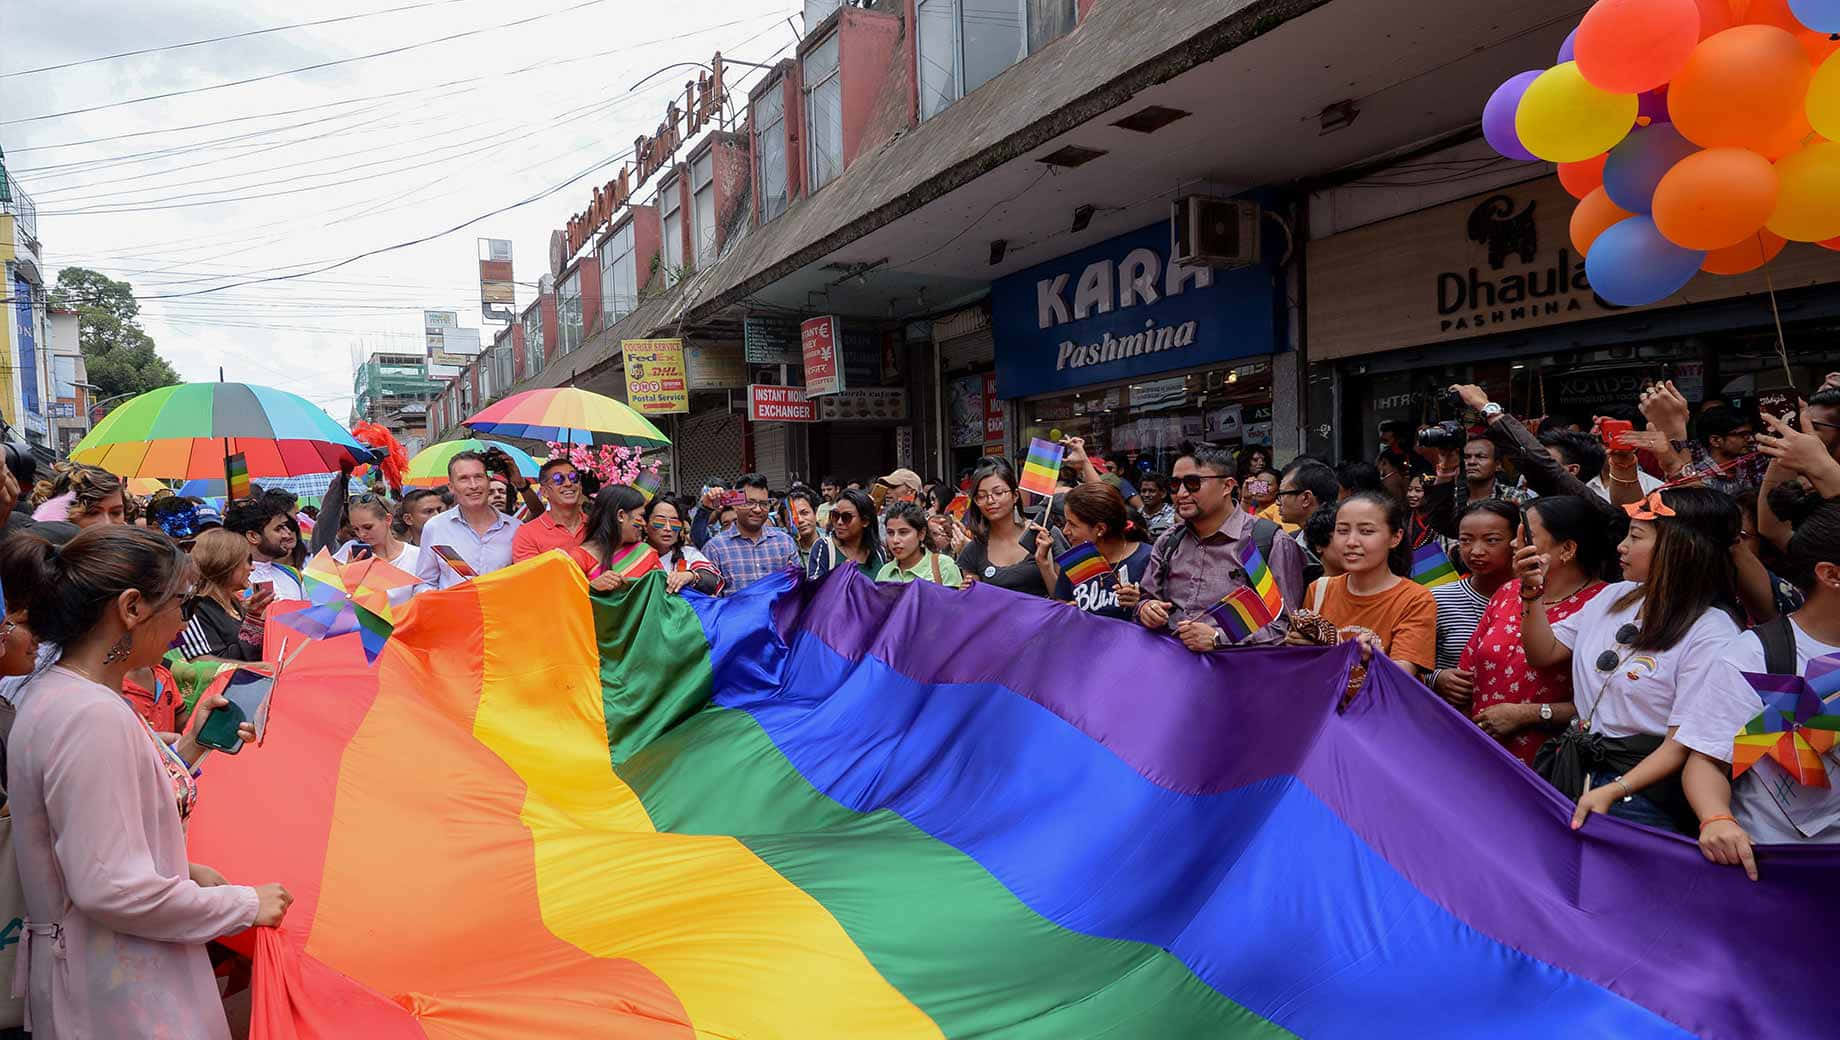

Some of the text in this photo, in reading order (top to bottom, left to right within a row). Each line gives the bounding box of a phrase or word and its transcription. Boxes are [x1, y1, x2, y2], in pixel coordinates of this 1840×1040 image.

[1037, 241, 1214, 329] KARA
[1437, 247, 1602, 315] Dhaula
[1440, 299, 1582, 332] PASHMINA
[623, 343, 682, 352] COURIER SERVICE
[1056, 318, 1198, 371] Pashmina
[628, 353, 678, 362] FedEx
[651, 367, 679, 377] DHL
[632, 393, 686, 402] Postal Service
[755, 388, 811, 403] INSTANT MONE
[759, 404, 811, 418] EXCHANGER
